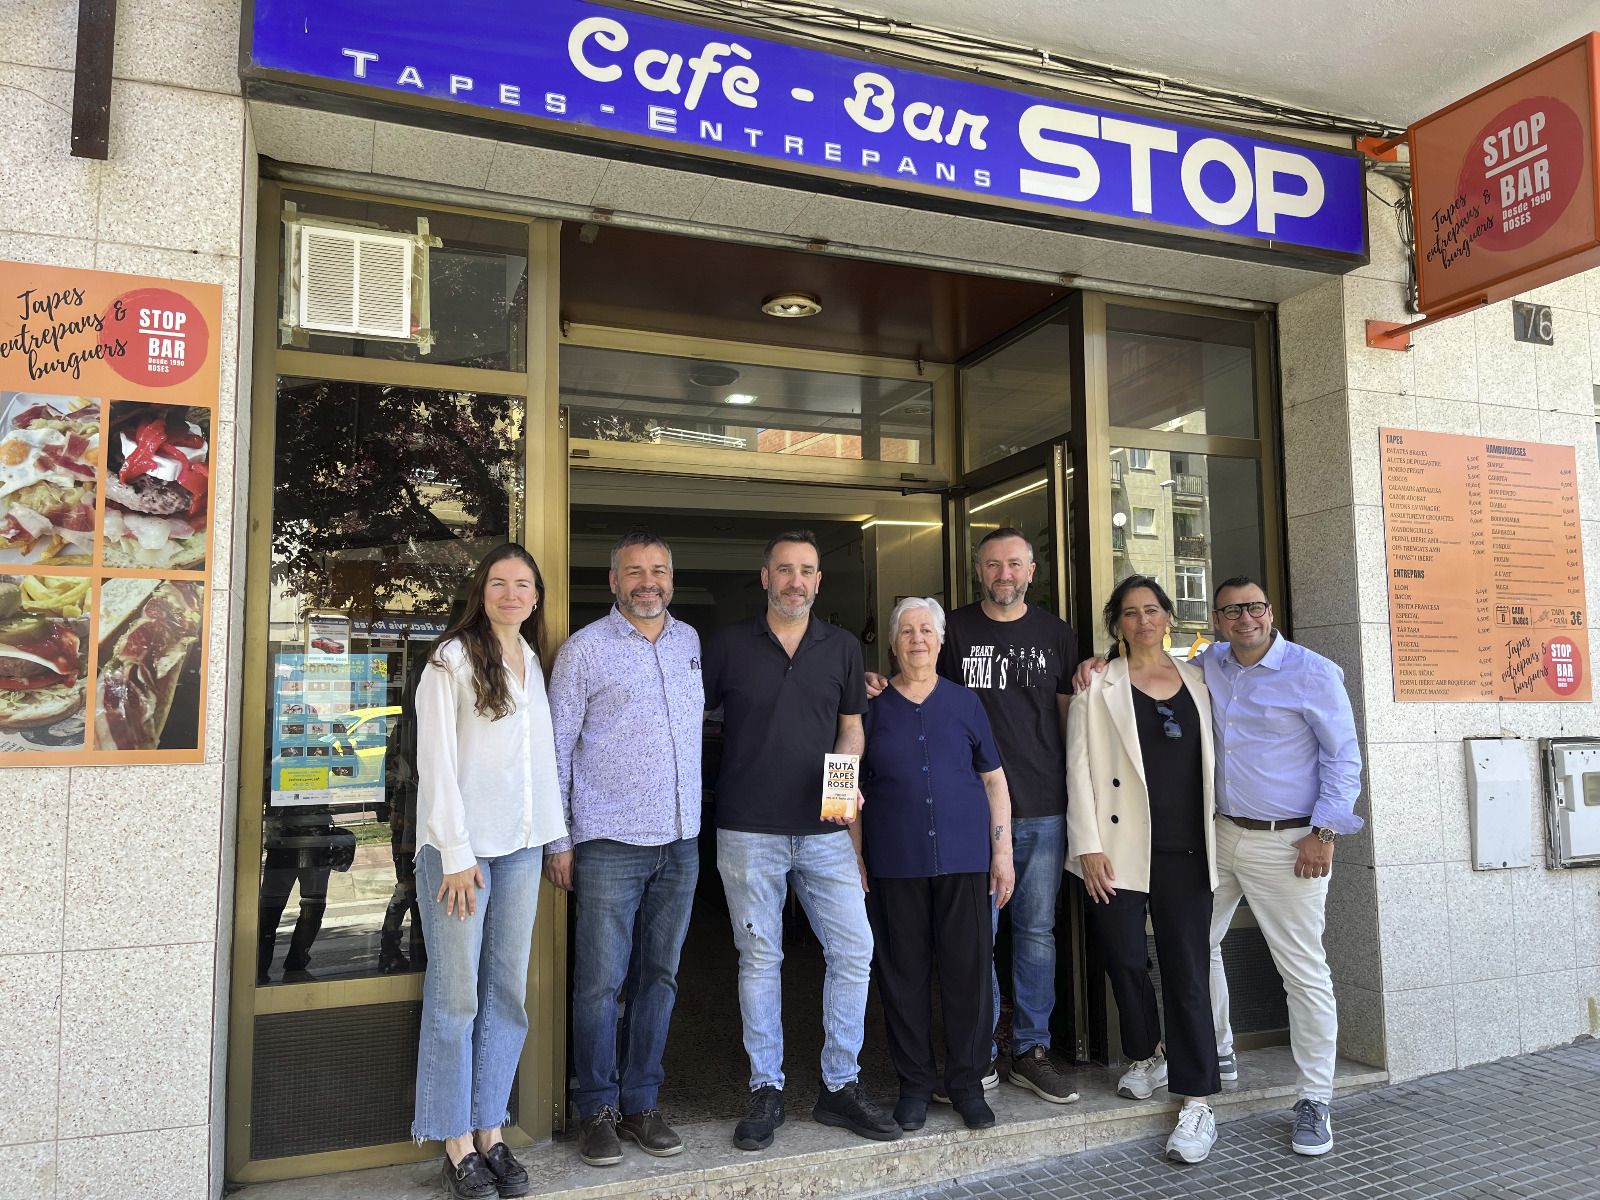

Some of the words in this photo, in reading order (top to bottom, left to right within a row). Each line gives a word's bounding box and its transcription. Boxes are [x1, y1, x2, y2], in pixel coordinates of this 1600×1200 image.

[1483, 111, 1546, 167] STOP
[844, 72, 989, 150] Bar
[1018, 105, 1325, 235] STOP
[1500, 158, 1551, 208] BAR
[1432, 193, 1467, 232] Tapes
[1502, 202, 1529, 220] Desde
[1531, 191, 1552, 208] 1990
[1503, 211, 1532, 233] ROSES
[1426, 205, 1480, 263] entrepans
[1442, 215, 1494, 270] burguers
[17, 287, 85, 321] Tapes
[0, 313, 106, 358] entrepans
[114, 300, 127, 321] &
[139, 308, 187, 330] STOP
[29, 338, 127, 380] burguers
[148, 337, 185, 359] BAR
[148, 365, 170, 373] ROSES
[170, 359, 185, 367] 1990
[1386, 435, 1404, 445] TAPES
[1393, 568, 1425, 579] ENTREPANS
[1570, 610, 1583, 626] 3€
[970, 645, 994, 657] PEAKY
[1505, 637, 1531, 659] Tapes
[1551, 643, 1572, 658] STOP
[1501, 652, 1539, 682] entrepans
[1556, 663, 1574, 677] BAR
[1512, 665, 1549, 694] burguers
[828, 762, 855, 771] RUTA
[828, 771, 855, 780] TAPES
[828, 781, 854, 789] ROSES
